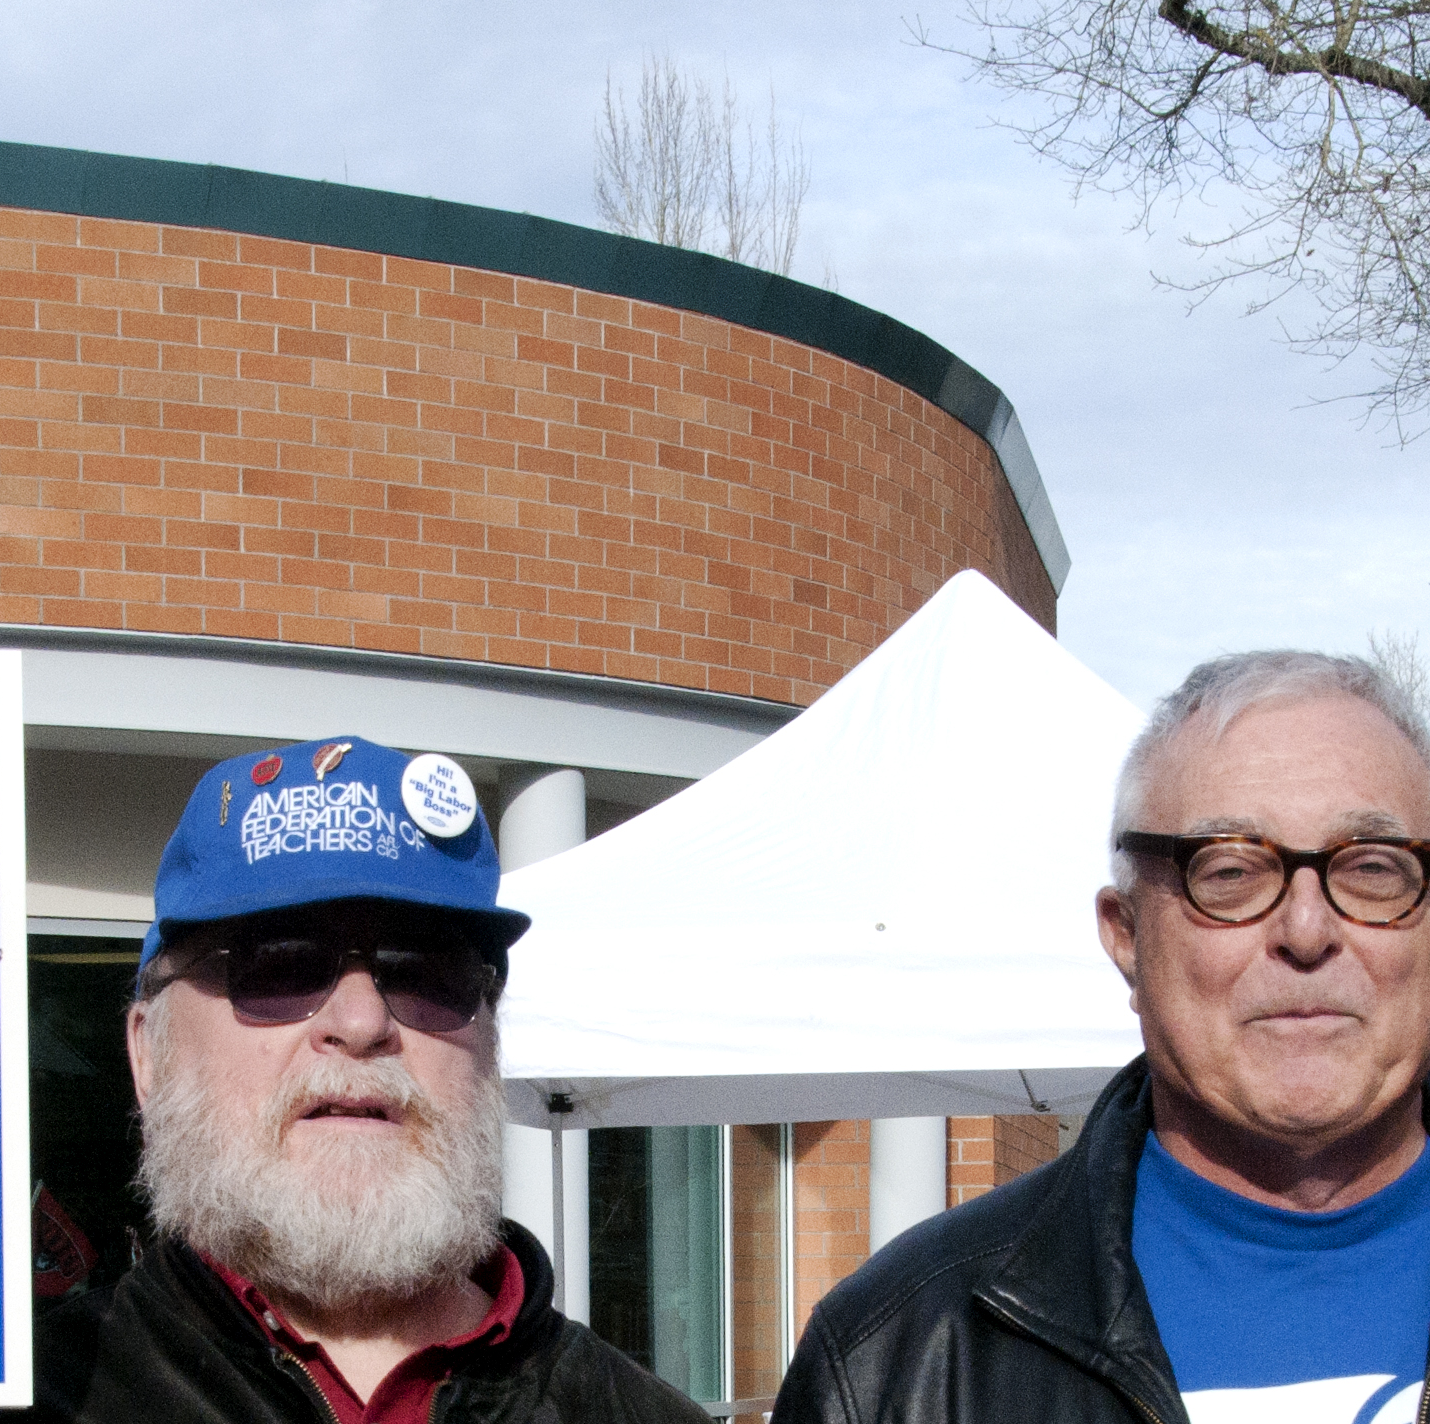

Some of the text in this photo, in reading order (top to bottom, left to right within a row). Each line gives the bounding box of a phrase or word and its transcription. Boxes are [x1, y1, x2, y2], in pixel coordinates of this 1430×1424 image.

[428, 774, 458, 794] I'm a
[435, 765, 454, 779] Hi!
[245, 781, 379, 824] AMERICAN
[438, 791, 472, 813] Labor
[240, 804, 396, 844] FEDERATION
[398, 820, 426, 853] OF
[241, 827, 373, 866] TEACHERS
